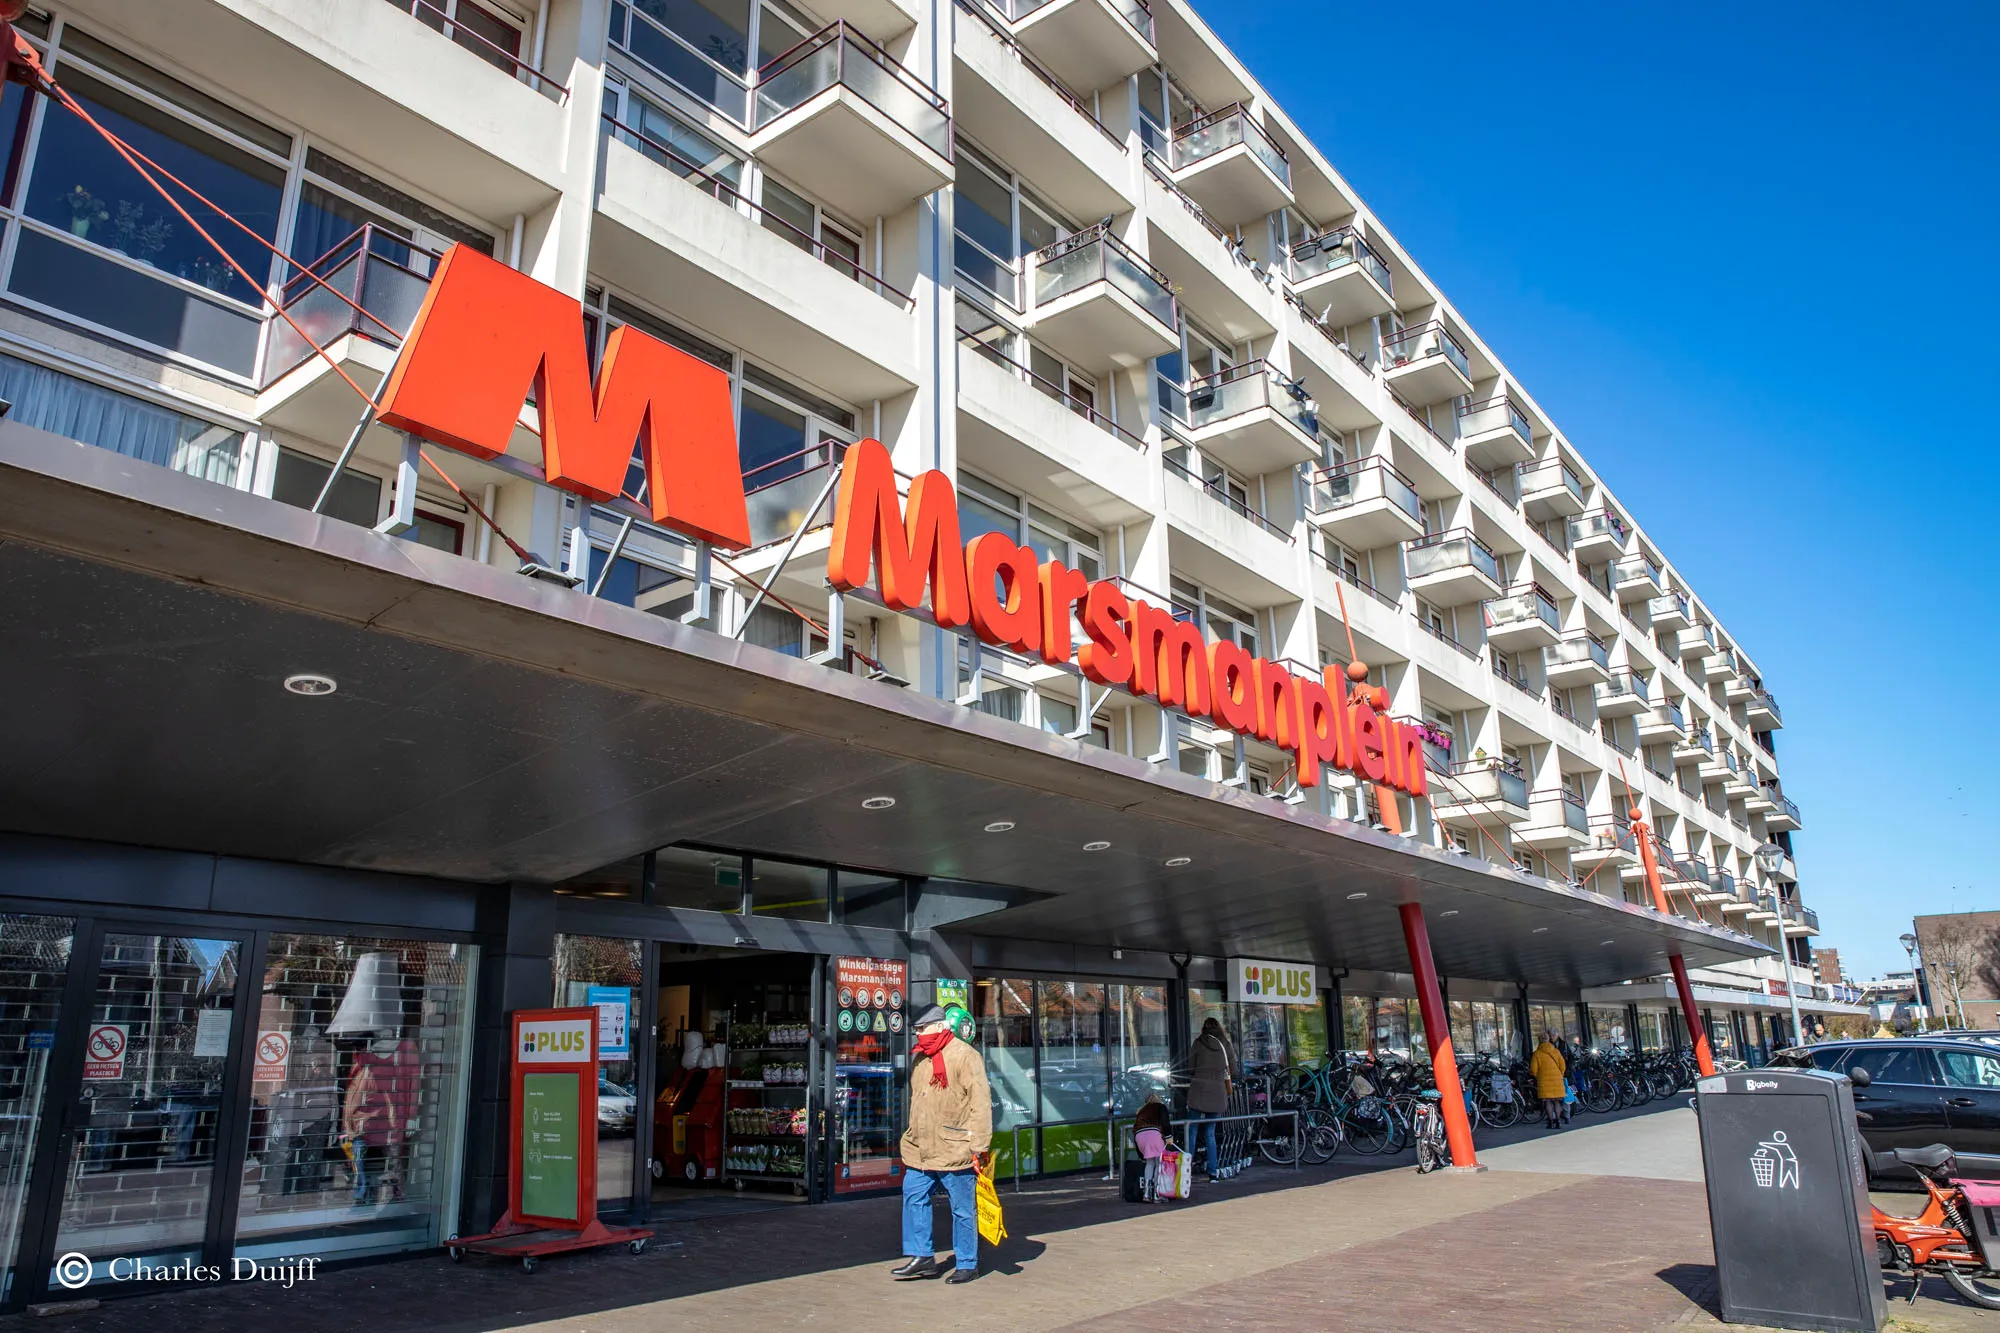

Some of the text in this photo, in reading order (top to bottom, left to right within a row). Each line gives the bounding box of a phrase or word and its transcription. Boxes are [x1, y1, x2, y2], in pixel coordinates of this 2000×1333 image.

[828, 437, 1427, 798] Marsmanplein
[838, 957, 903, 975] Winkelpassage
[840, 971, 902, 986] Marsmanplein
[1261, 967, 1312, 998] PLUS
[537, 1030, 585, 1053] PLUS
[1746, 1079, 1778, 1091] Bigbelly
